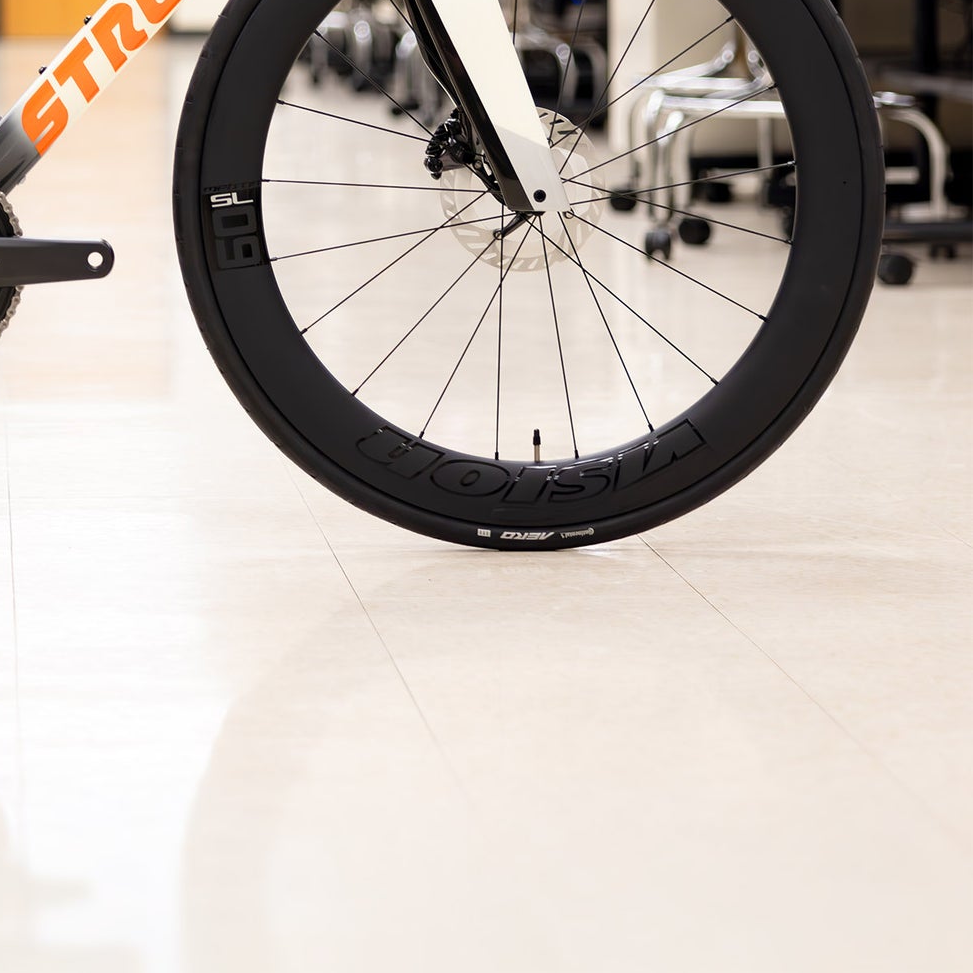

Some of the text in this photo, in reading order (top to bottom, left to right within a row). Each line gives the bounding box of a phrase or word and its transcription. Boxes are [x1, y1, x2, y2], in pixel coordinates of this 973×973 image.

[210, 191, 254, 208] SL
[211, 205, 262, 270] 60
[499, 531, 555, 541] AERO
